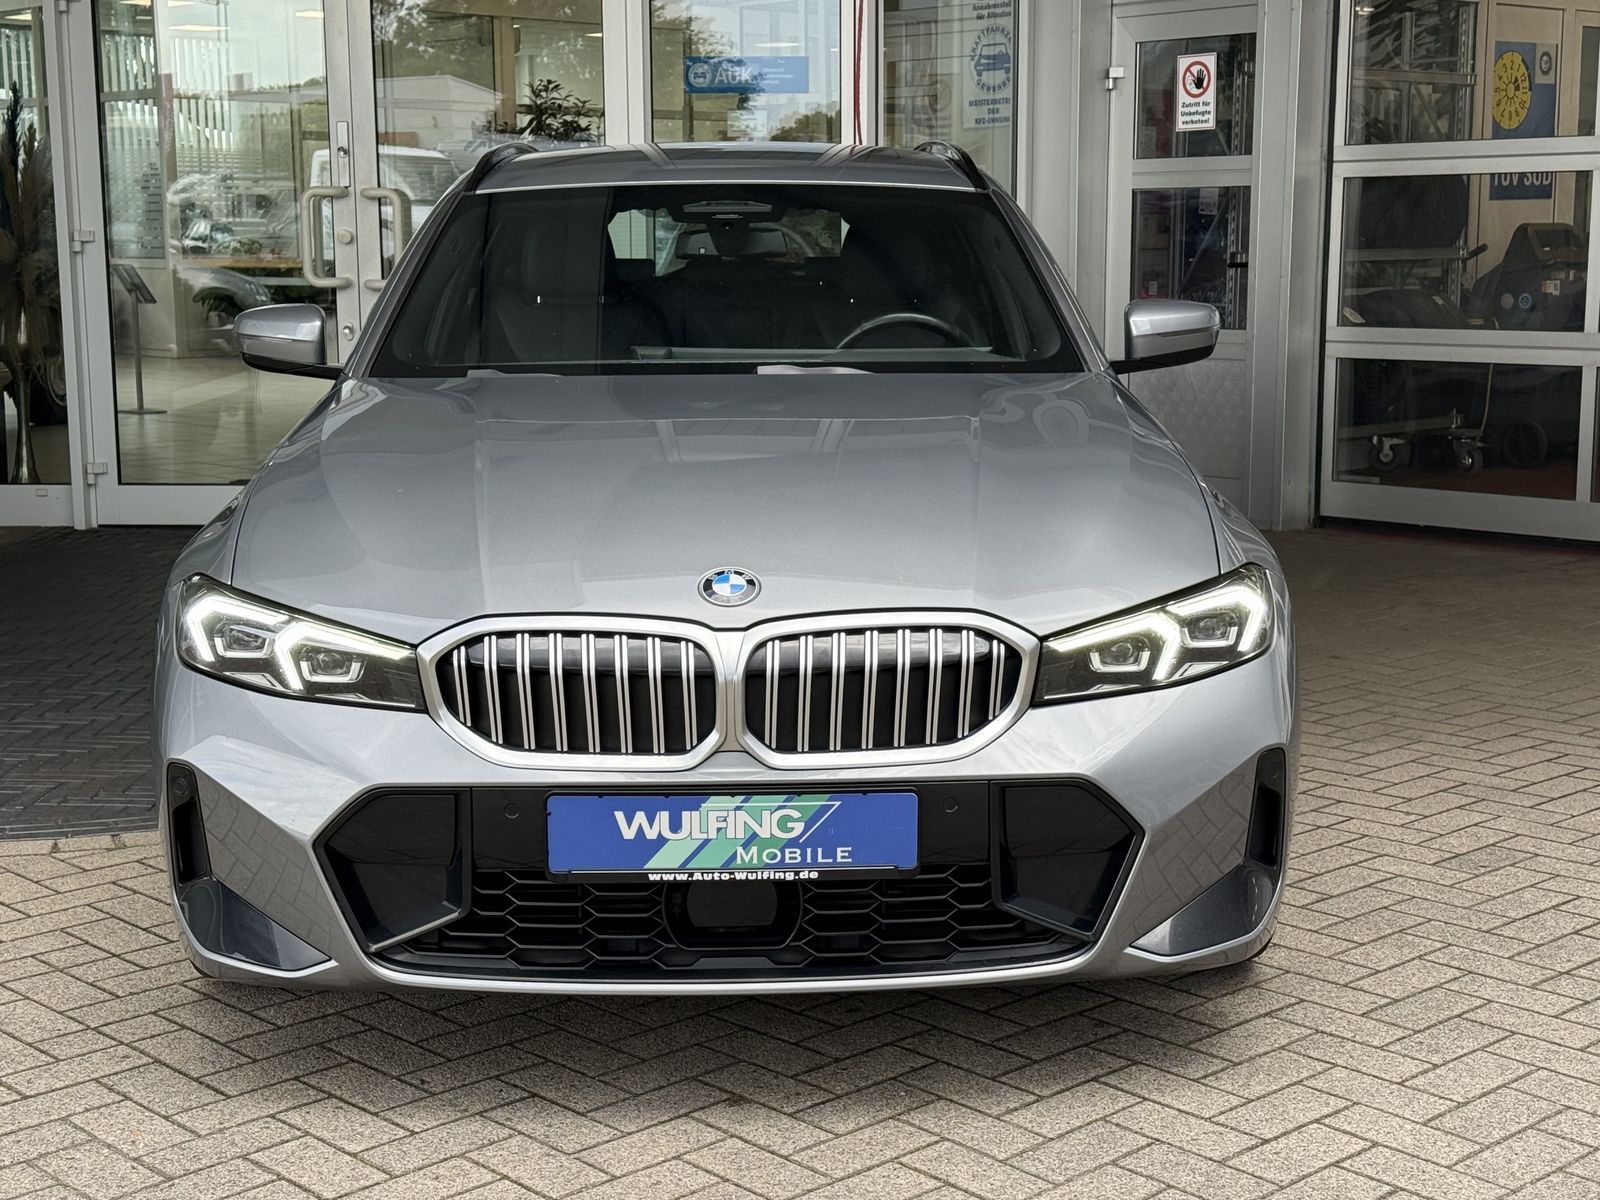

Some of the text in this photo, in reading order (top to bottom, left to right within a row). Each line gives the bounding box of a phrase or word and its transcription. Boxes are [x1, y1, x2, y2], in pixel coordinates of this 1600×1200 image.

[987, 107, 999, 115] DER
[613, 808, 805, 840] WULFING
[736, 846, 853, 864] MOBILE
[648, 871, 819, 881] www.Auto-Wulfing.de
